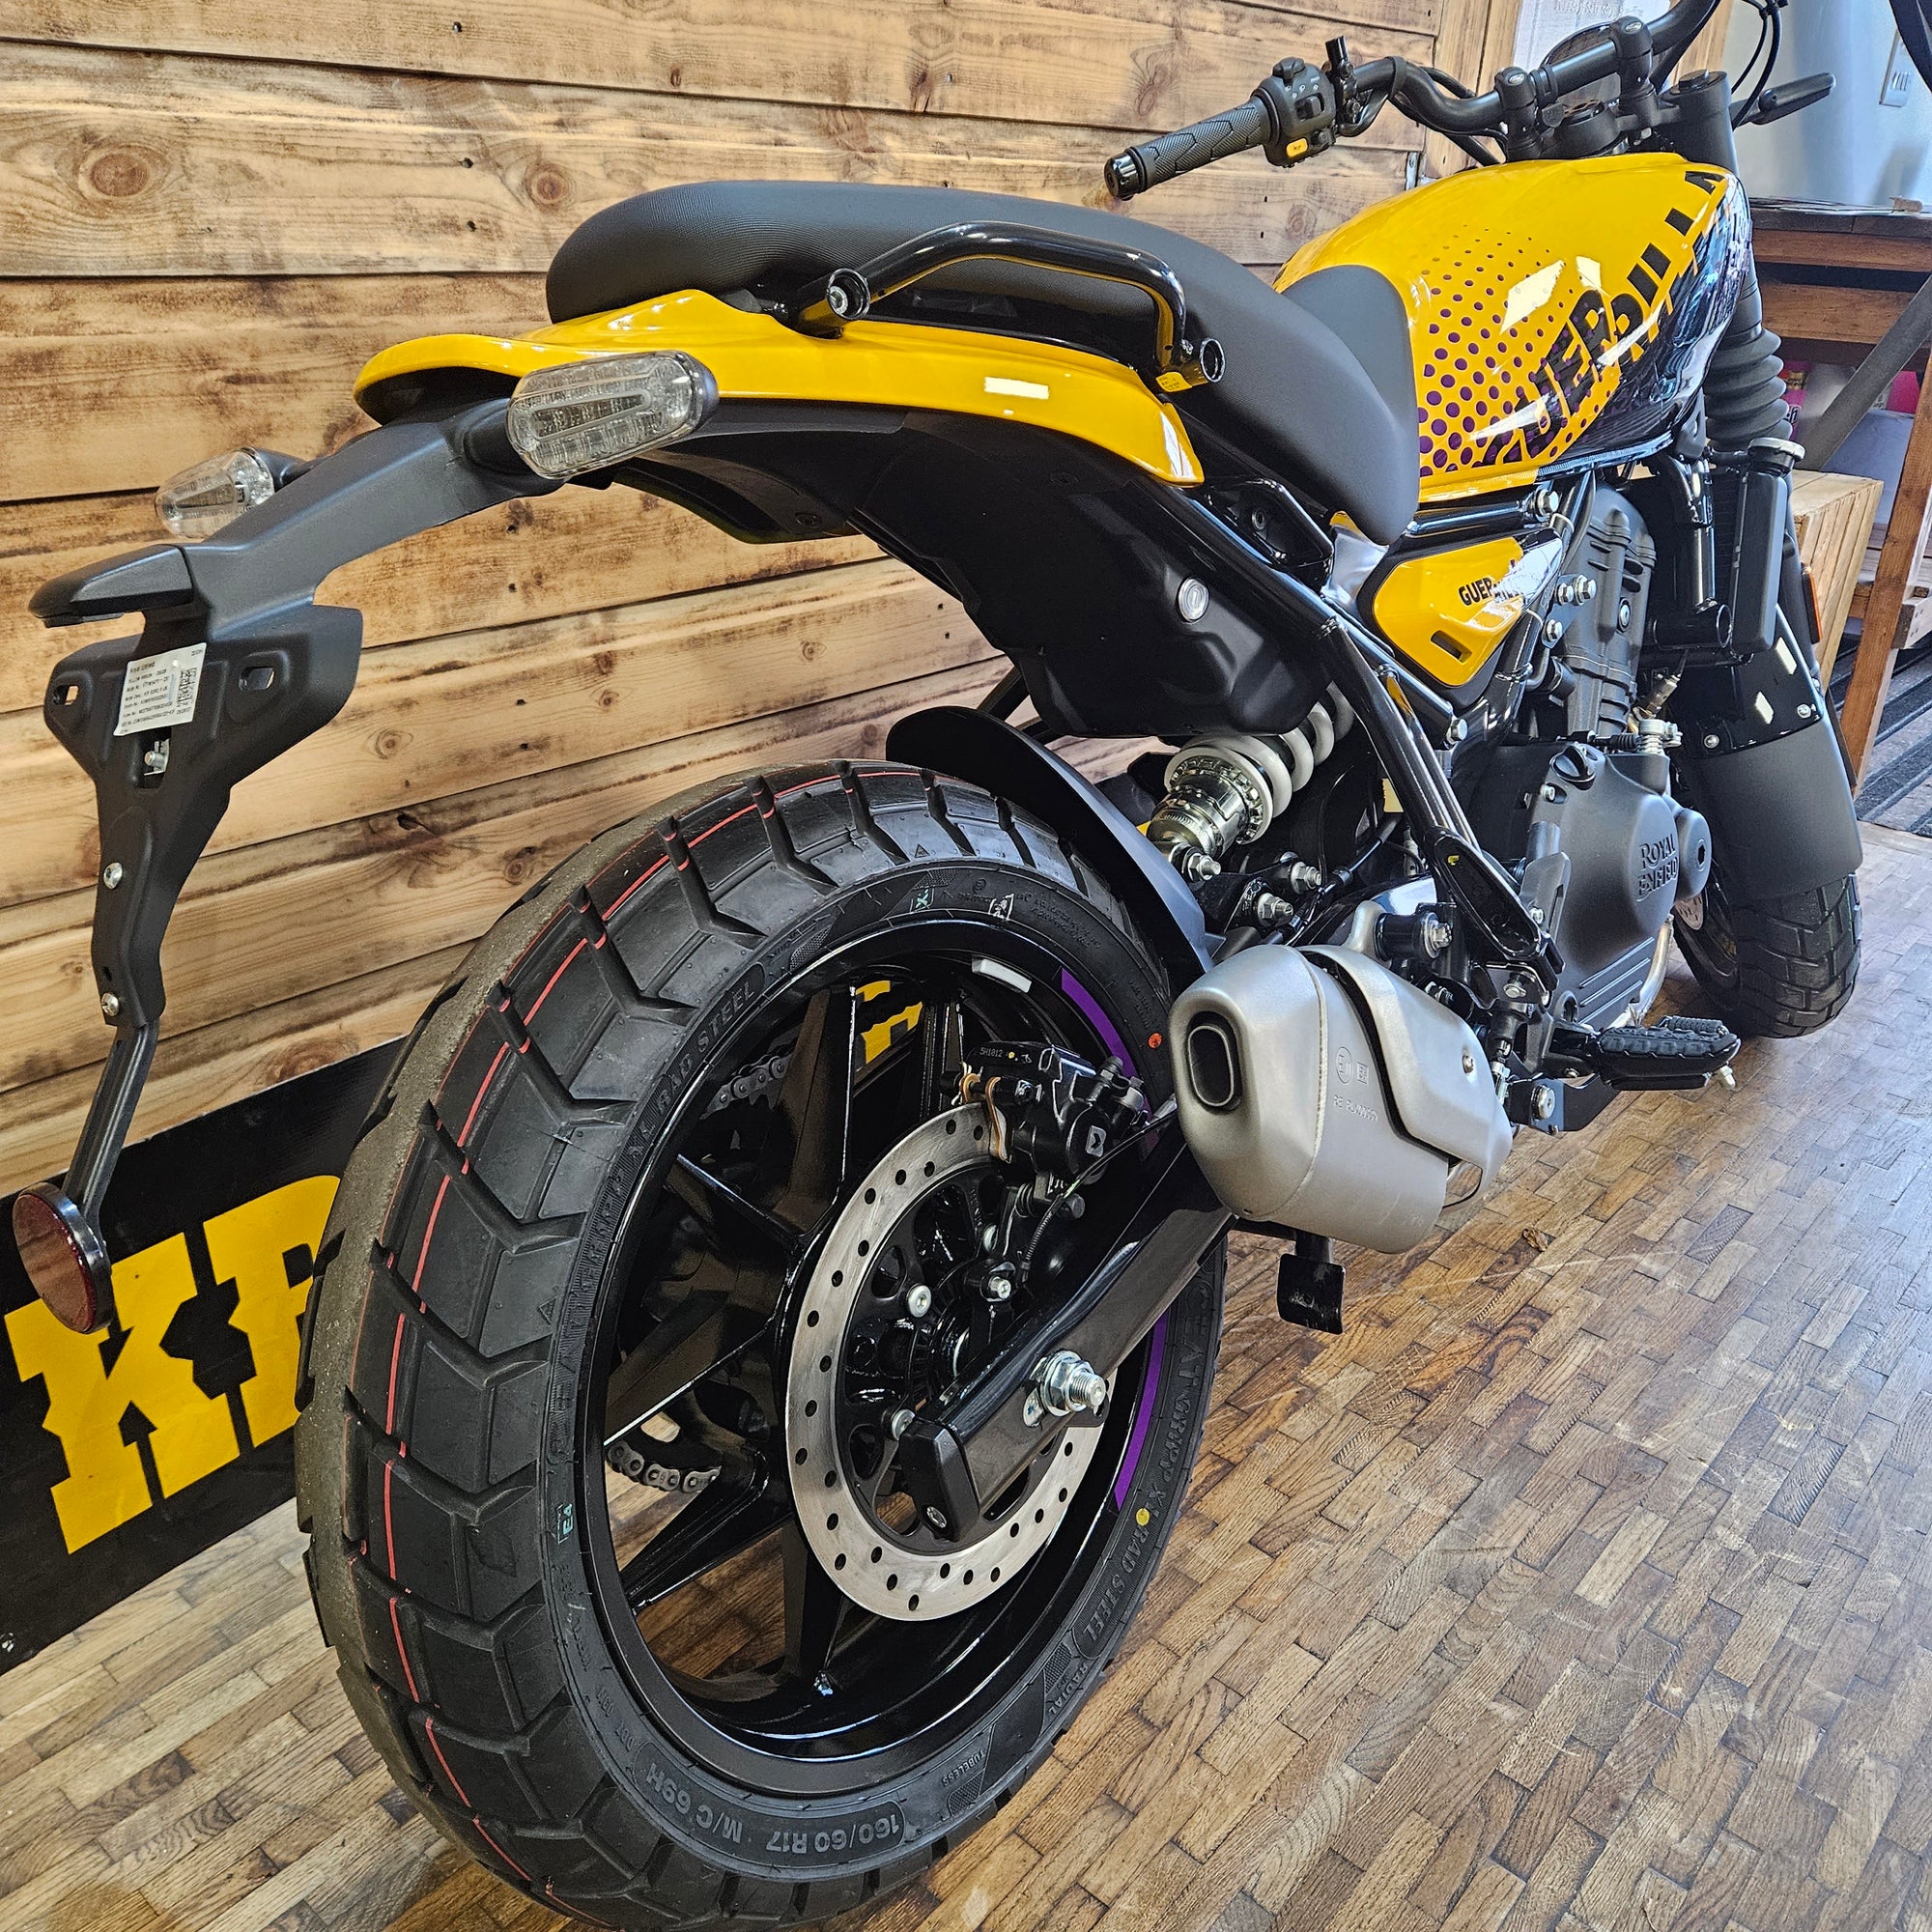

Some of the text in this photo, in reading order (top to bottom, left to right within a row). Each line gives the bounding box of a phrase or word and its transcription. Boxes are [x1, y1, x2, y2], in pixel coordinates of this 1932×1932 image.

[1636, 857, 1678, 896] ENFIELD
[1639, 834, 1676, 869] ROYAL
[696, 980, 756, 1054] STEEL
[1122, 1526, 1151, 1574] RAD
[1083, 1573, 1126, 1642] STEEL
[1048, 1663, 1089, 1716] RADIAL
[941, 1749, 986, 1787] TUBELESS
[644, 1763, 901, 1855] 160/60 R17 M/C 69H
